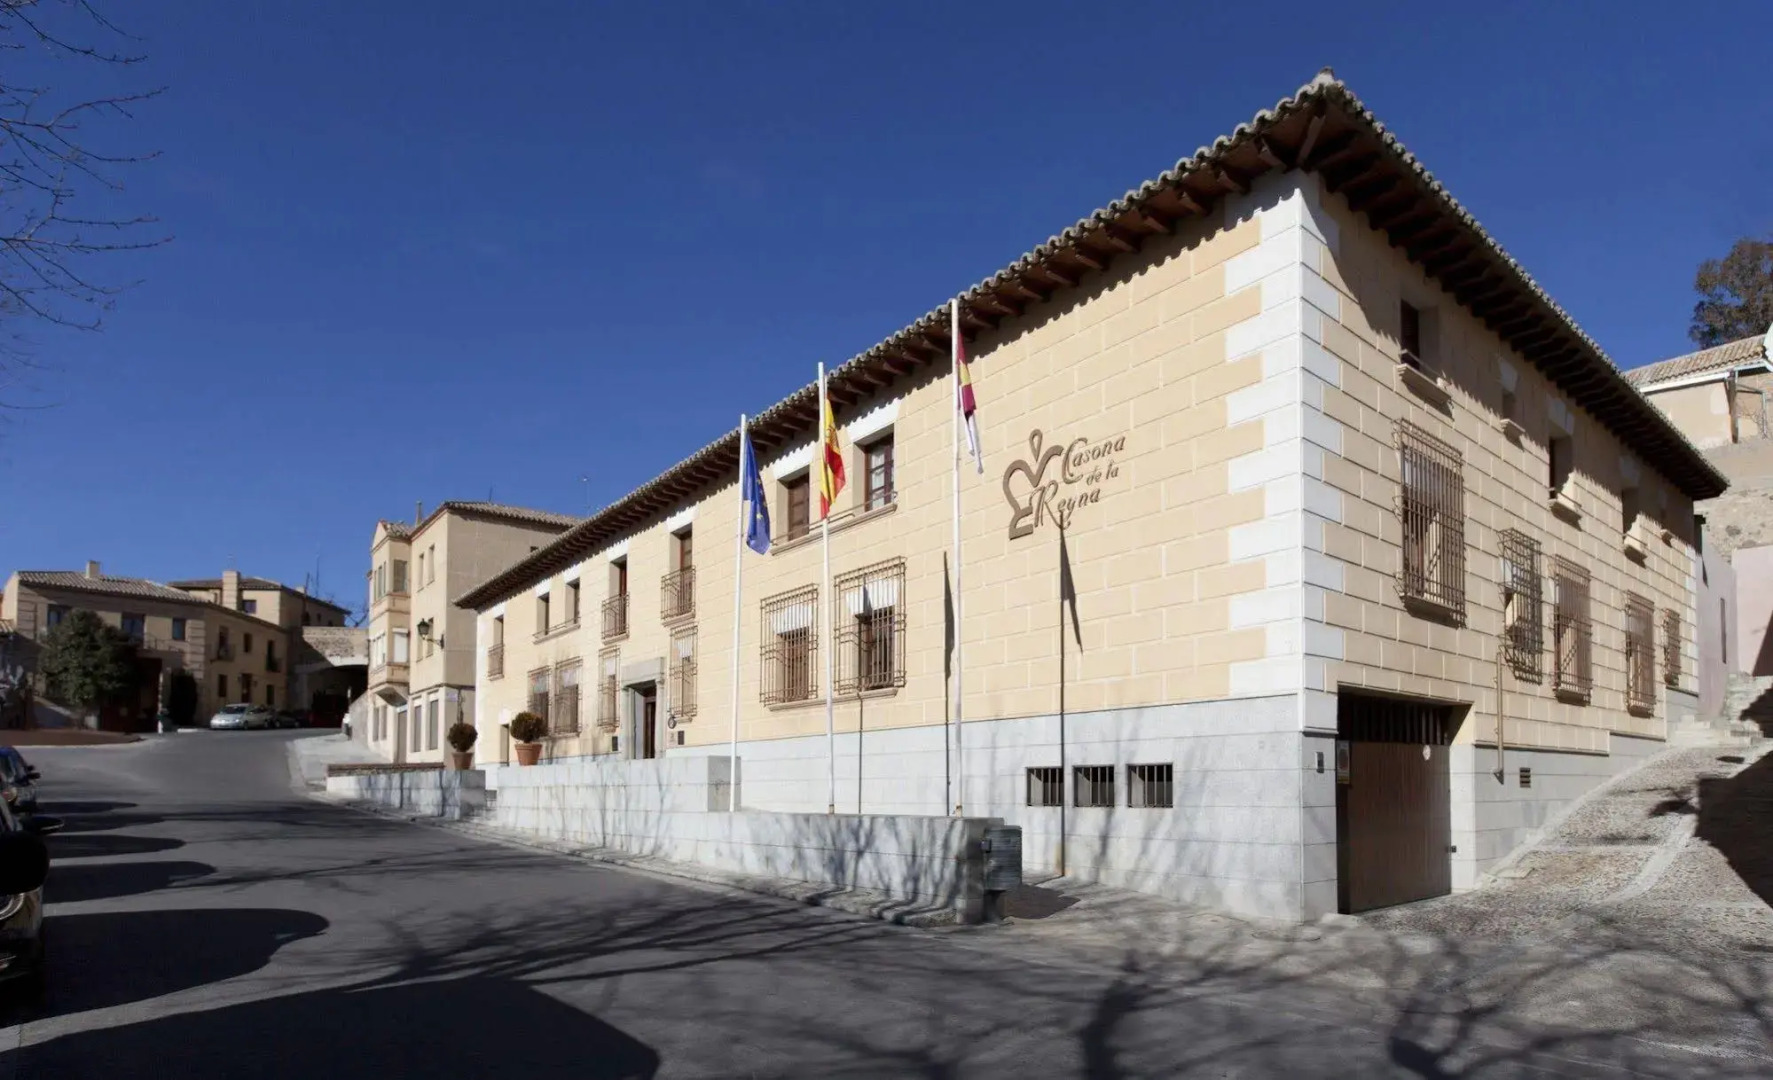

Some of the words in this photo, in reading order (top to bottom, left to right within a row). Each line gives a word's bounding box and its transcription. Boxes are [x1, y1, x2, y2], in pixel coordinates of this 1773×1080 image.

[1061, 436, 1126, 484] Casona
[1086, 465, 1102, 486] de
[1105, 459, 1119, 480] la
[1029, 479, 1101, 530] Reyna
